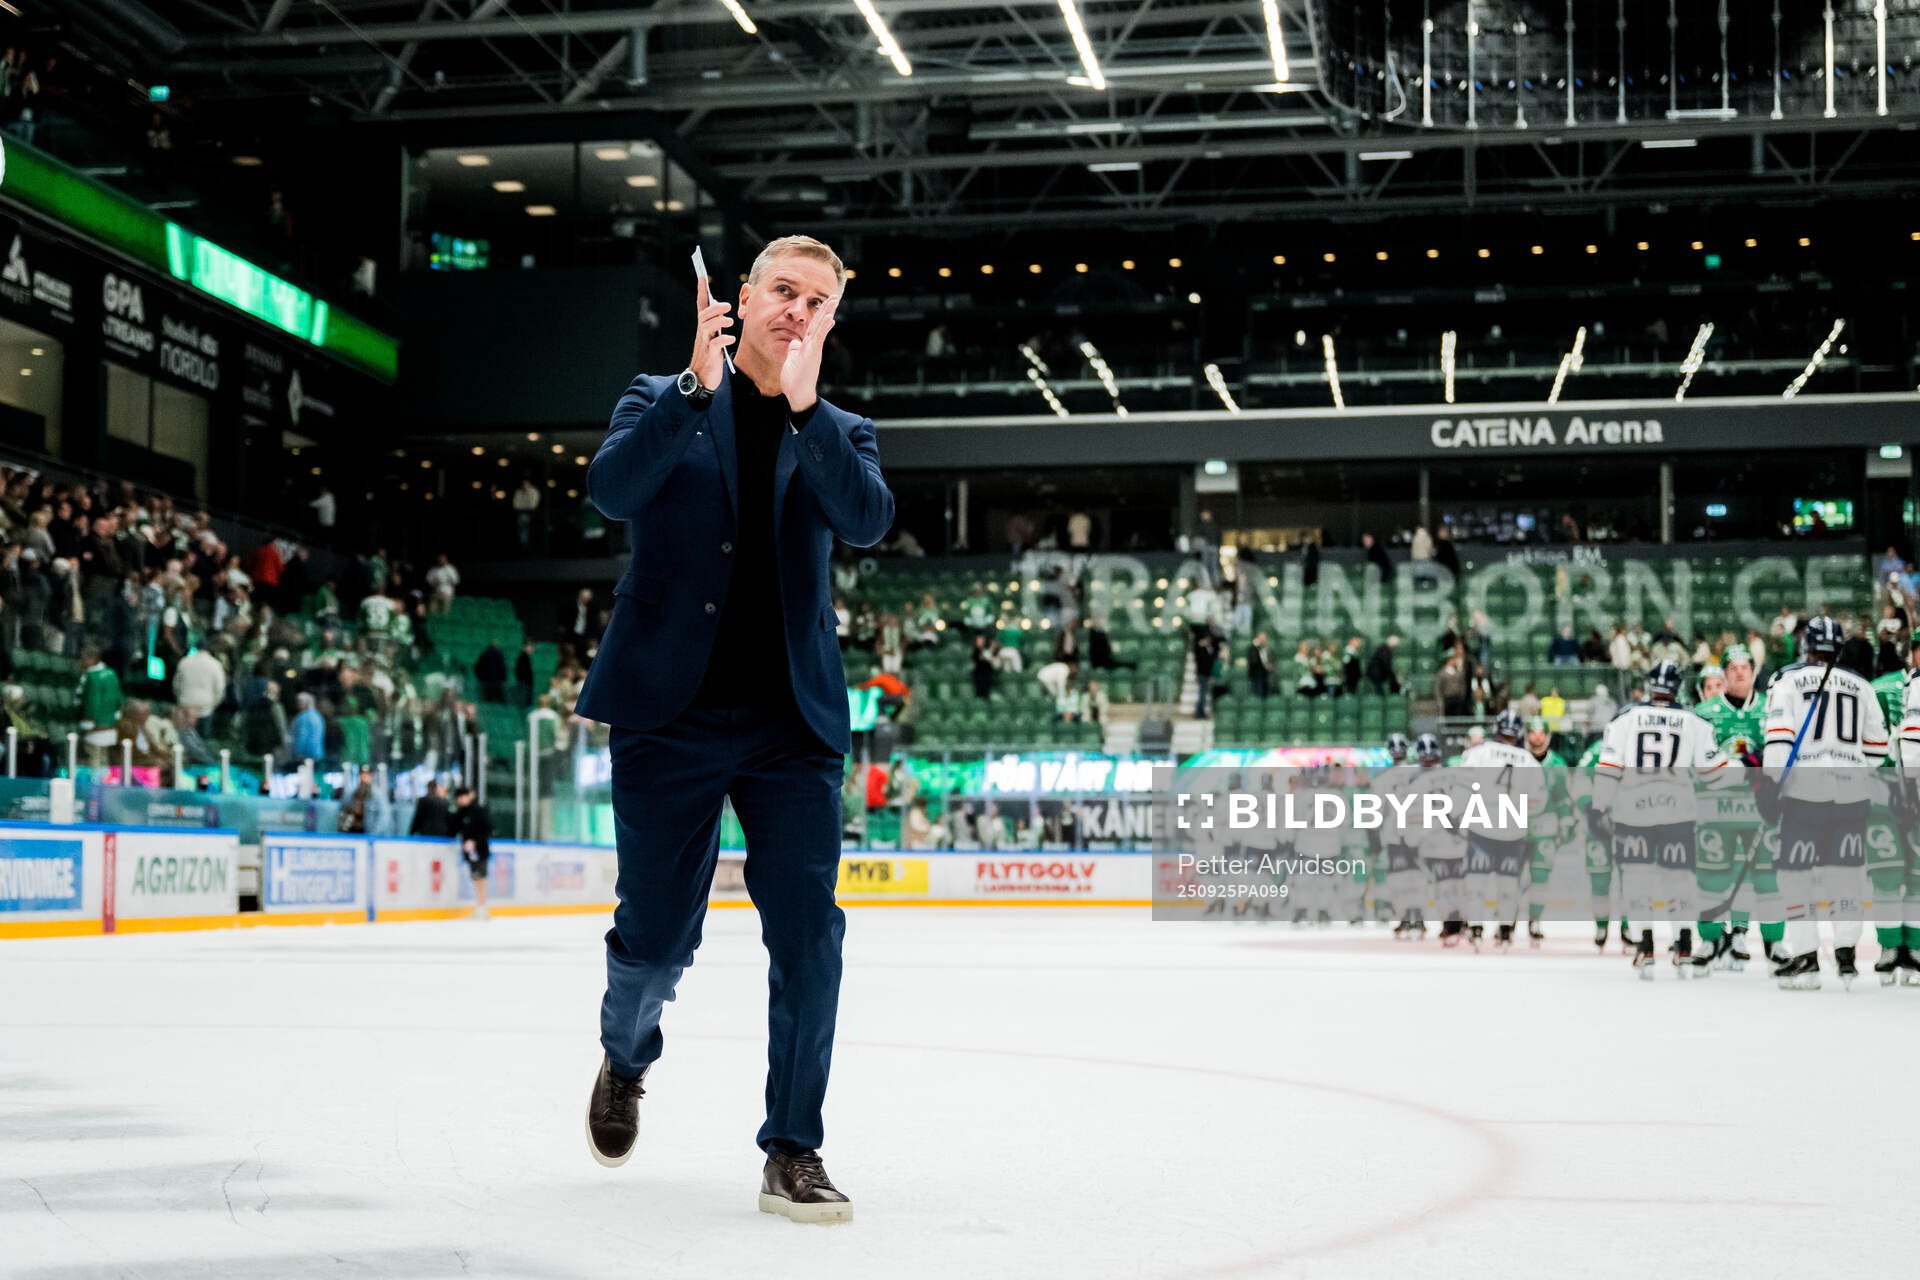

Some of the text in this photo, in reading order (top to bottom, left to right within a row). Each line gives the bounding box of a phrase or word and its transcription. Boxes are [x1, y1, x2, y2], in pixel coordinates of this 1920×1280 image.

[103, 273, 144, 323] GPA
[1431, 416, 1664, 448] CATENA Arena
[1802, 690, 1858, 744] 70
[1637, 731, 1681, 776] 61
[132, 856, 229, 896] AGRIZON
[847, 862, 891, 881] MVB
[976, 862, 1096, 880] FLYTGOLV
